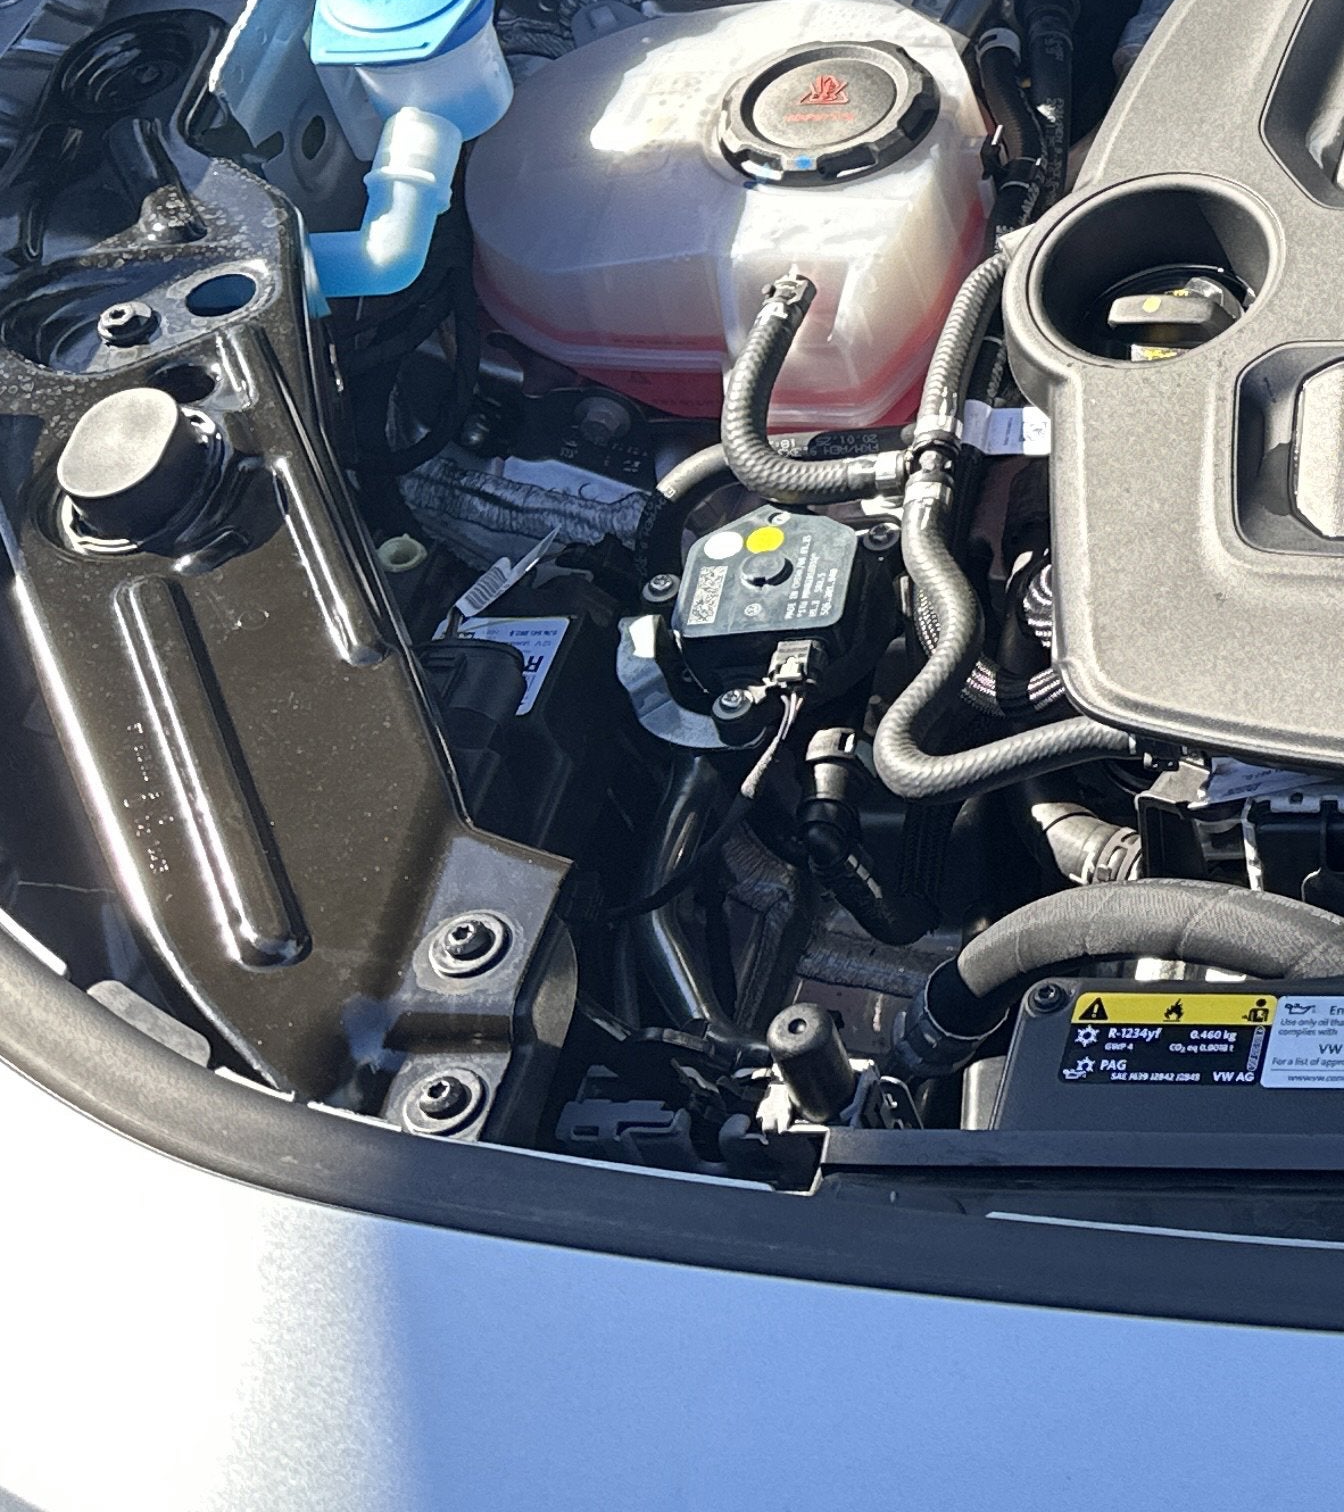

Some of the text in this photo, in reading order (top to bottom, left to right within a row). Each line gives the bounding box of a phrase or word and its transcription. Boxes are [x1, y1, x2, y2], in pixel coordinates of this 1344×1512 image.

[1298, 1019, 1317, 1028] only
[1108, 1028, 1238, 1042] R-1234yf 0.460 kg
[1278, 1028, 1338, 1037] complies with
[1105, 1043, 1126, 1051] GWP
[1187, 1044, 1198, 1053] eq
[1319, 1044, 1343, 1055] VW
[1100, 1059, 1127, 1071] PAG
[1272, 1057, 1286, 1065] For
[1295, 1057, 1308, 1065] list
[1310, 1057, 1320, 1065] of
[1110, 1072, 1127, 1080] SAE
[1213, 1071, 1235, 1082] VW
[1236, 1072, 1255, 1082] AG
